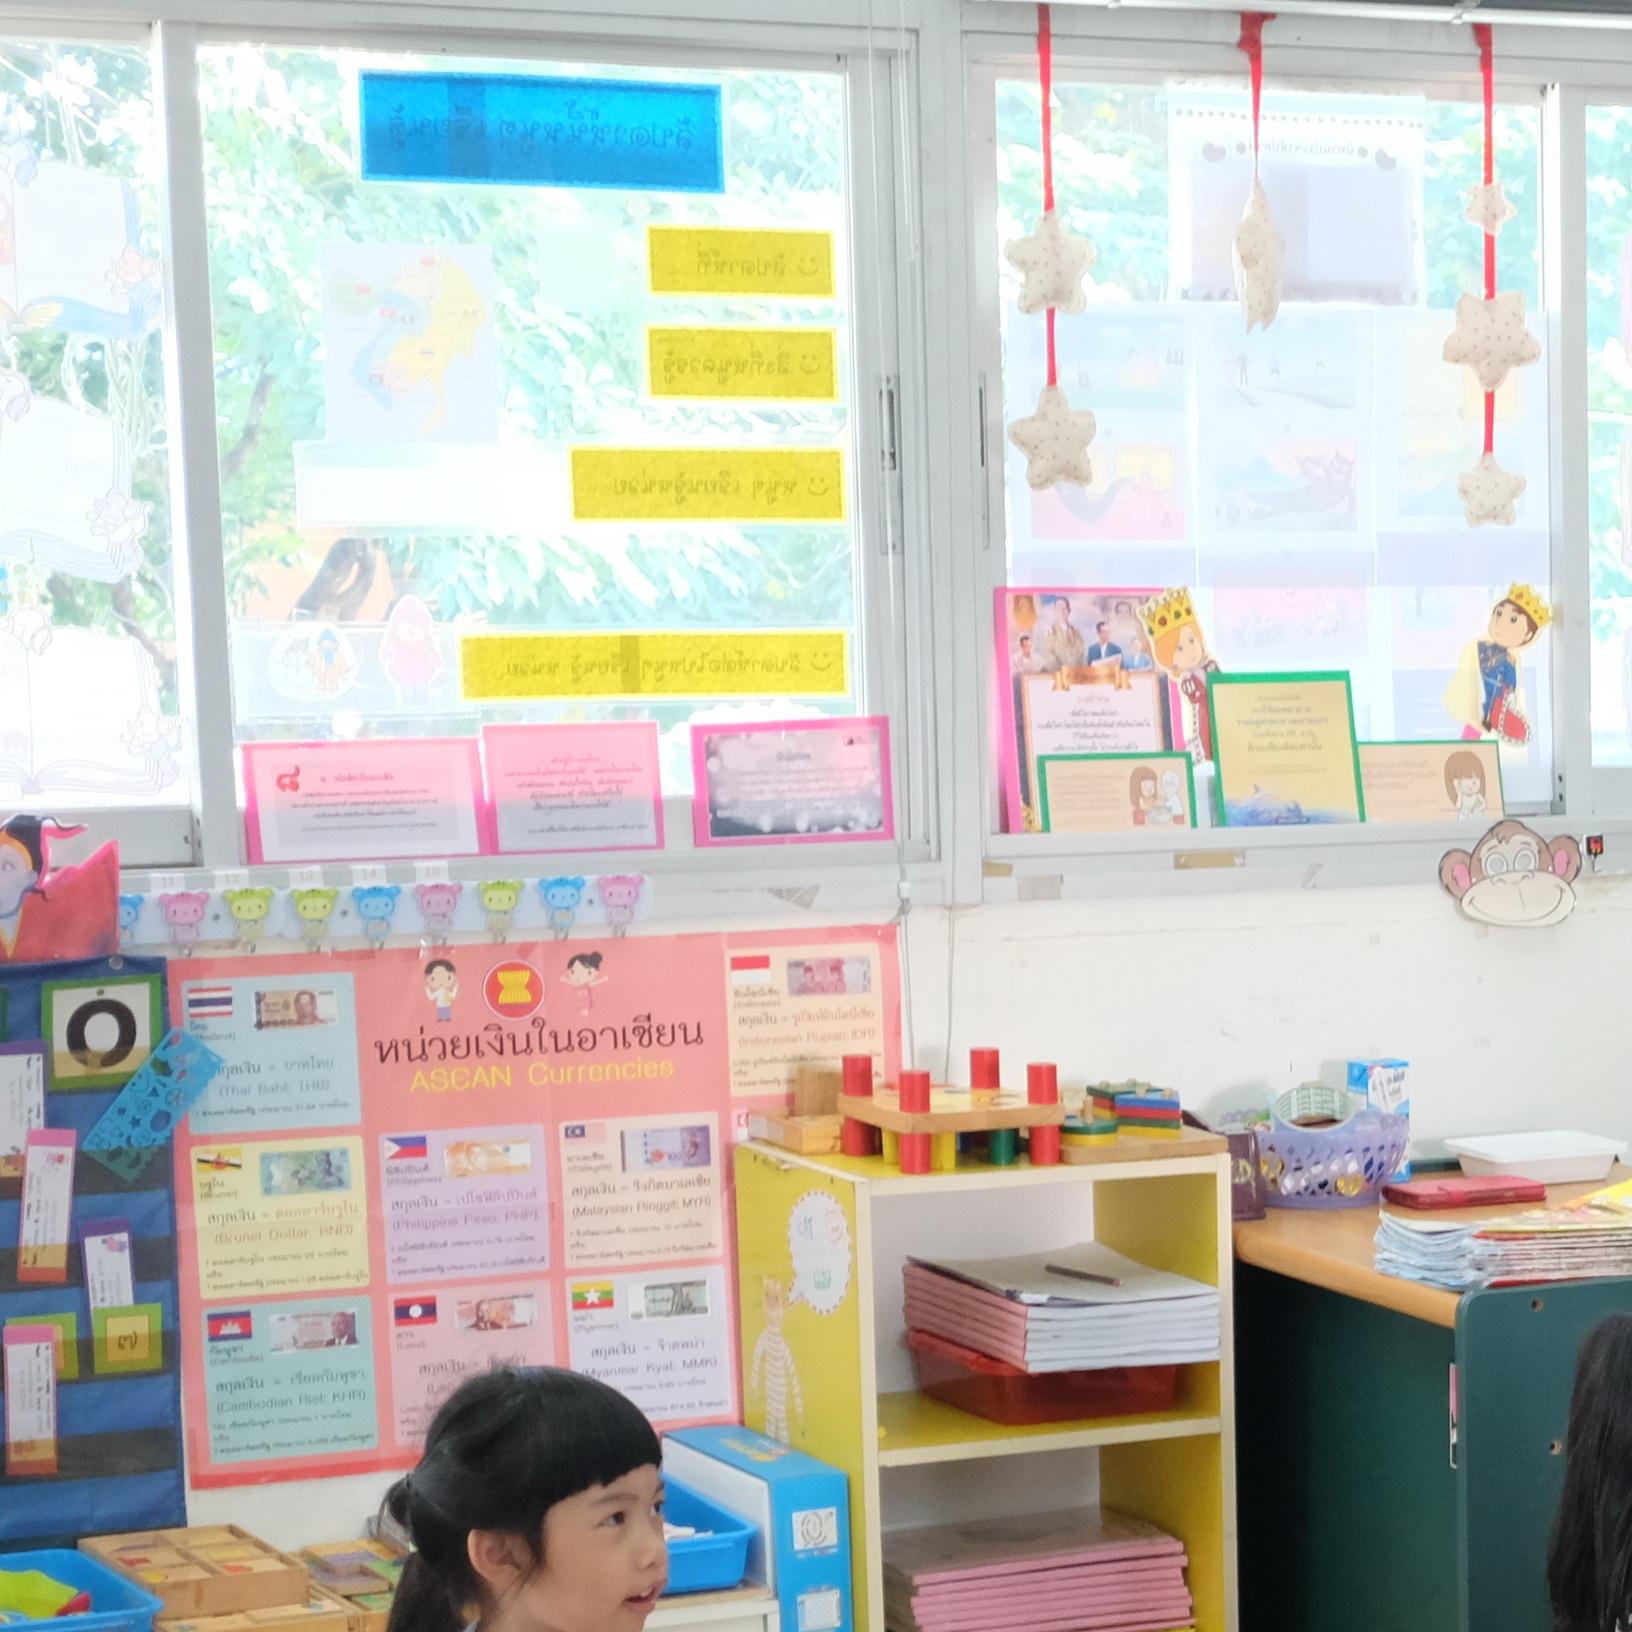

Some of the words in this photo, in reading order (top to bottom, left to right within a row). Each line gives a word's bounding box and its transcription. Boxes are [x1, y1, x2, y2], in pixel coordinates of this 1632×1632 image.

[374, 1012, 705, 1065] หน่วยเงินในอาเซียน
[410, 1064, 513, 1094] ASEAN
[527, 1056, 675, 1087] Currencies
